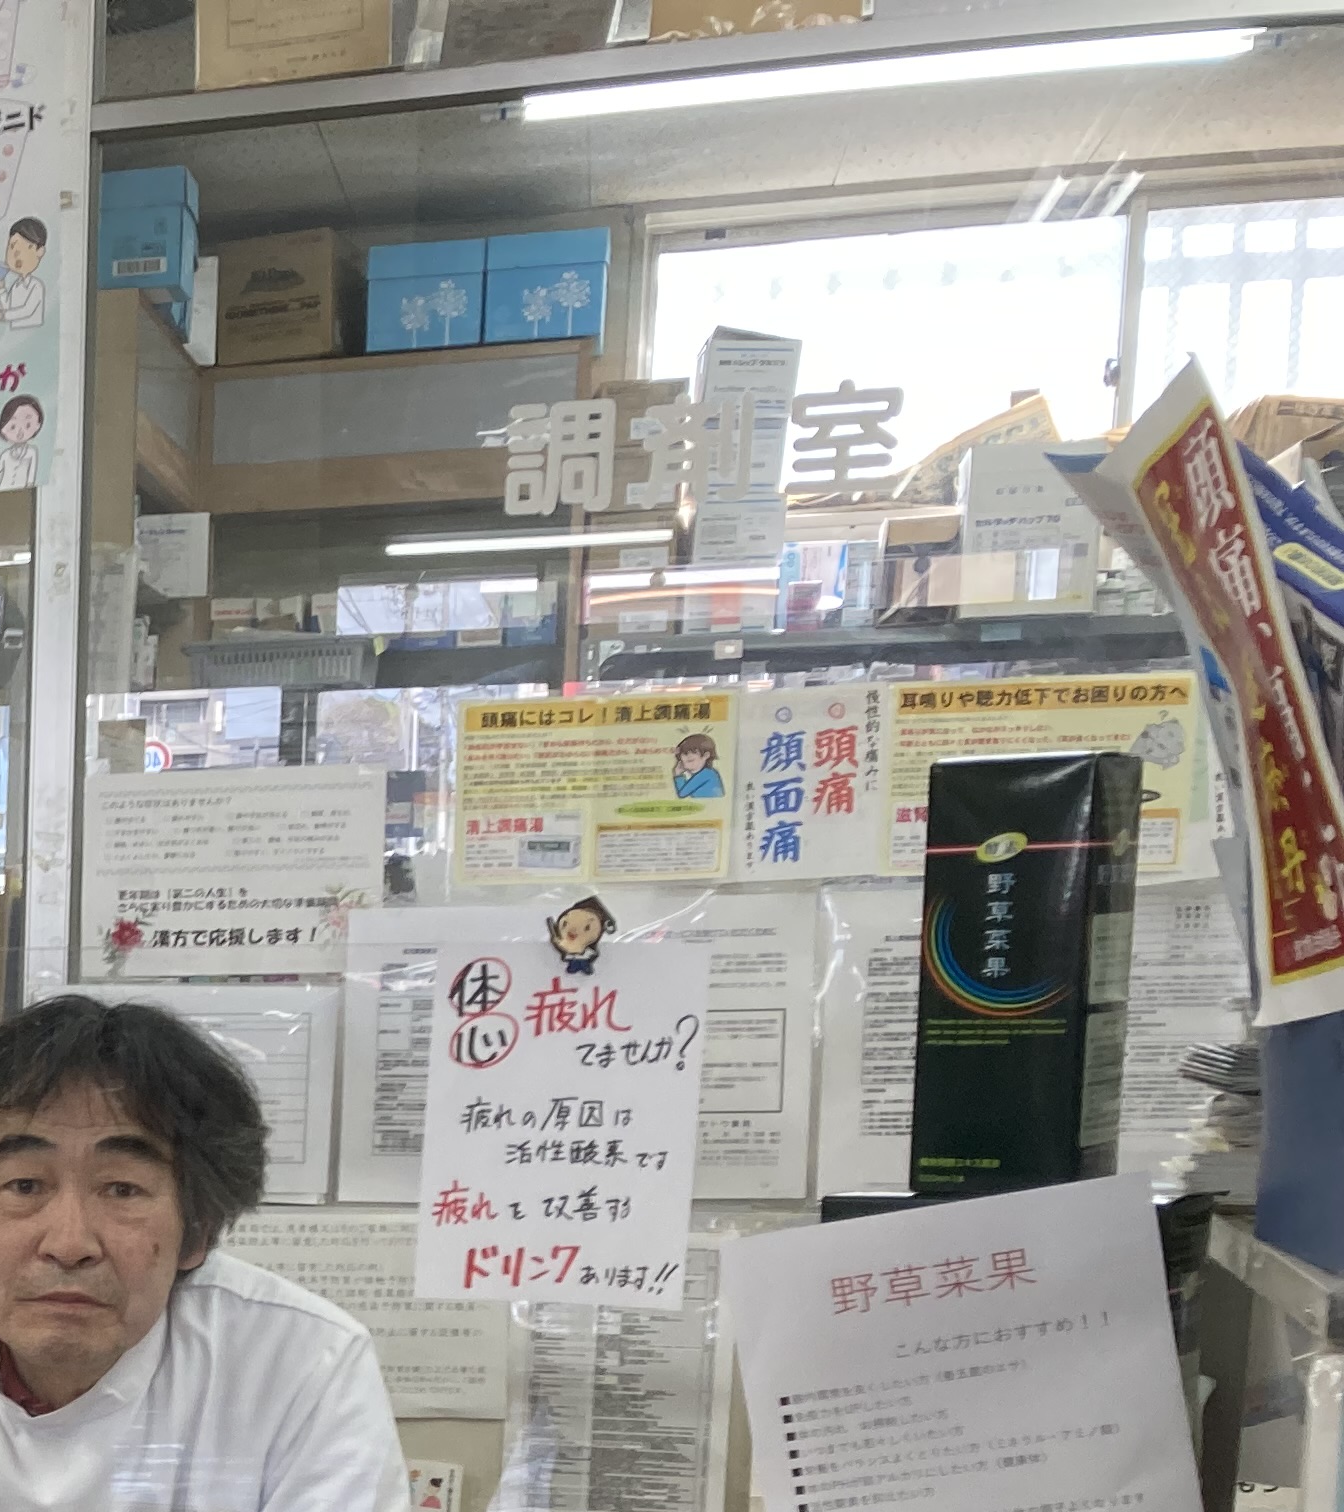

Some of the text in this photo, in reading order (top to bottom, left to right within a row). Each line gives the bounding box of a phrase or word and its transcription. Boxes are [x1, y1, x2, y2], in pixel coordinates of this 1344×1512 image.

[505, 379, 904, 517] 調剤室
[758, 729, 807, 864] 顔面痛
[812, 725, 860, 816] 頭痛
[524, 975, 632, 1038] 疲れ
[459, 1096, 632, 1134] 疲れの原因は
[504, 1140, 668, 1171] 活性酸素です
[830, 1246, 1038, 1316] 野草菜果
